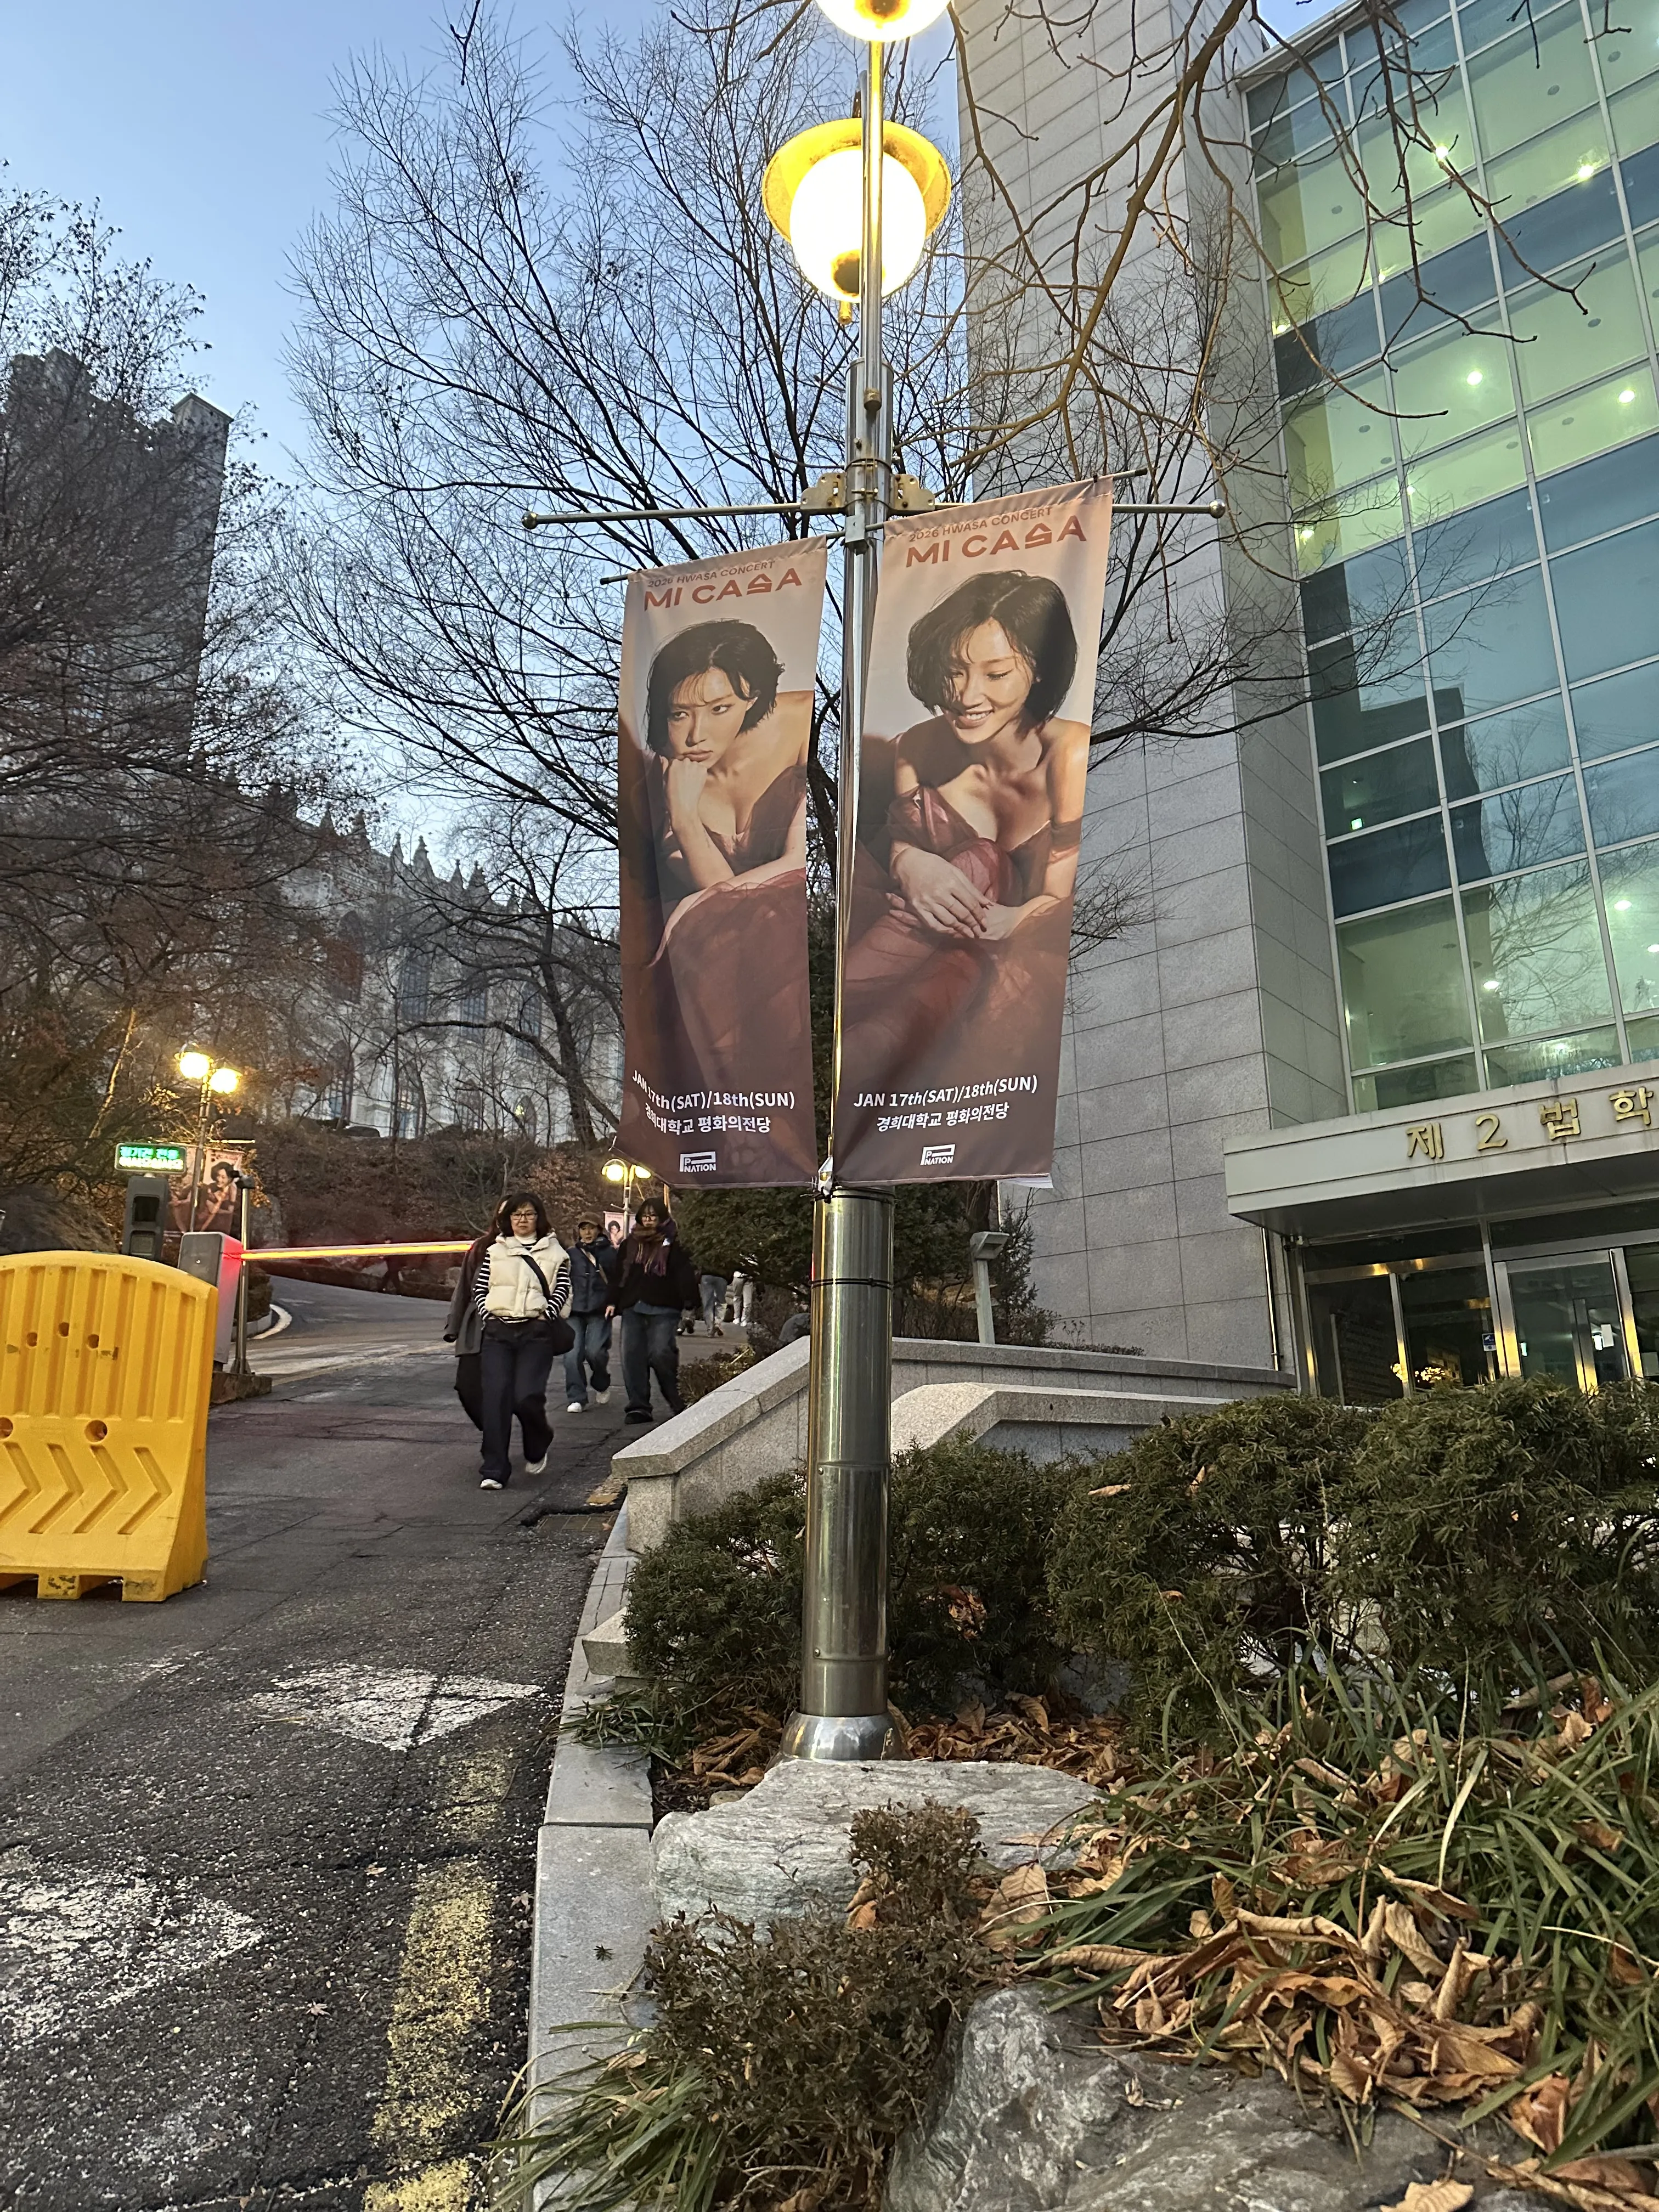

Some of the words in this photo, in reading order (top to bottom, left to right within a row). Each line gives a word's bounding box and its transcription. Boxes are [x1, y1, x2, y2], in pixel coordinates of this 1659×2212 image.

[909, 528, 939, 542] 2026
[943, 520, 988, 535] HWASA
[991, 507, 1052, 526] CONCERT
[906, 539, 950, 567] MI
[961, 515, 1087, 558] CASA
[644, 587, 683, 612] MI
[691, 568, 802, 604] CASA
[647, 577, 674, 588] 2026
[676, 571, 717, 584] HWASA
[721, 560, 776, 577] CONCERT
[633, 1070, 648, 1093] JAN
[647, 1086, 795, 1113] 17th(SAT)/18th(SUN)
[854, 1093, 885, 1107] JAN
[889, 1075, 1038, 1107] 17th(SAT)/18th(SUN)
[645, 1103, 694, 1135] 경희대학교
[698, 1115, 771, 1133] 평화의전당
[877, 1112, 942, 1132] 경희대학교
[946, 1102, 1009, 1126] 평화의전당
[684, 1164, 716, 1172] NATION
[924, 1156, 953, 1165] NATION
